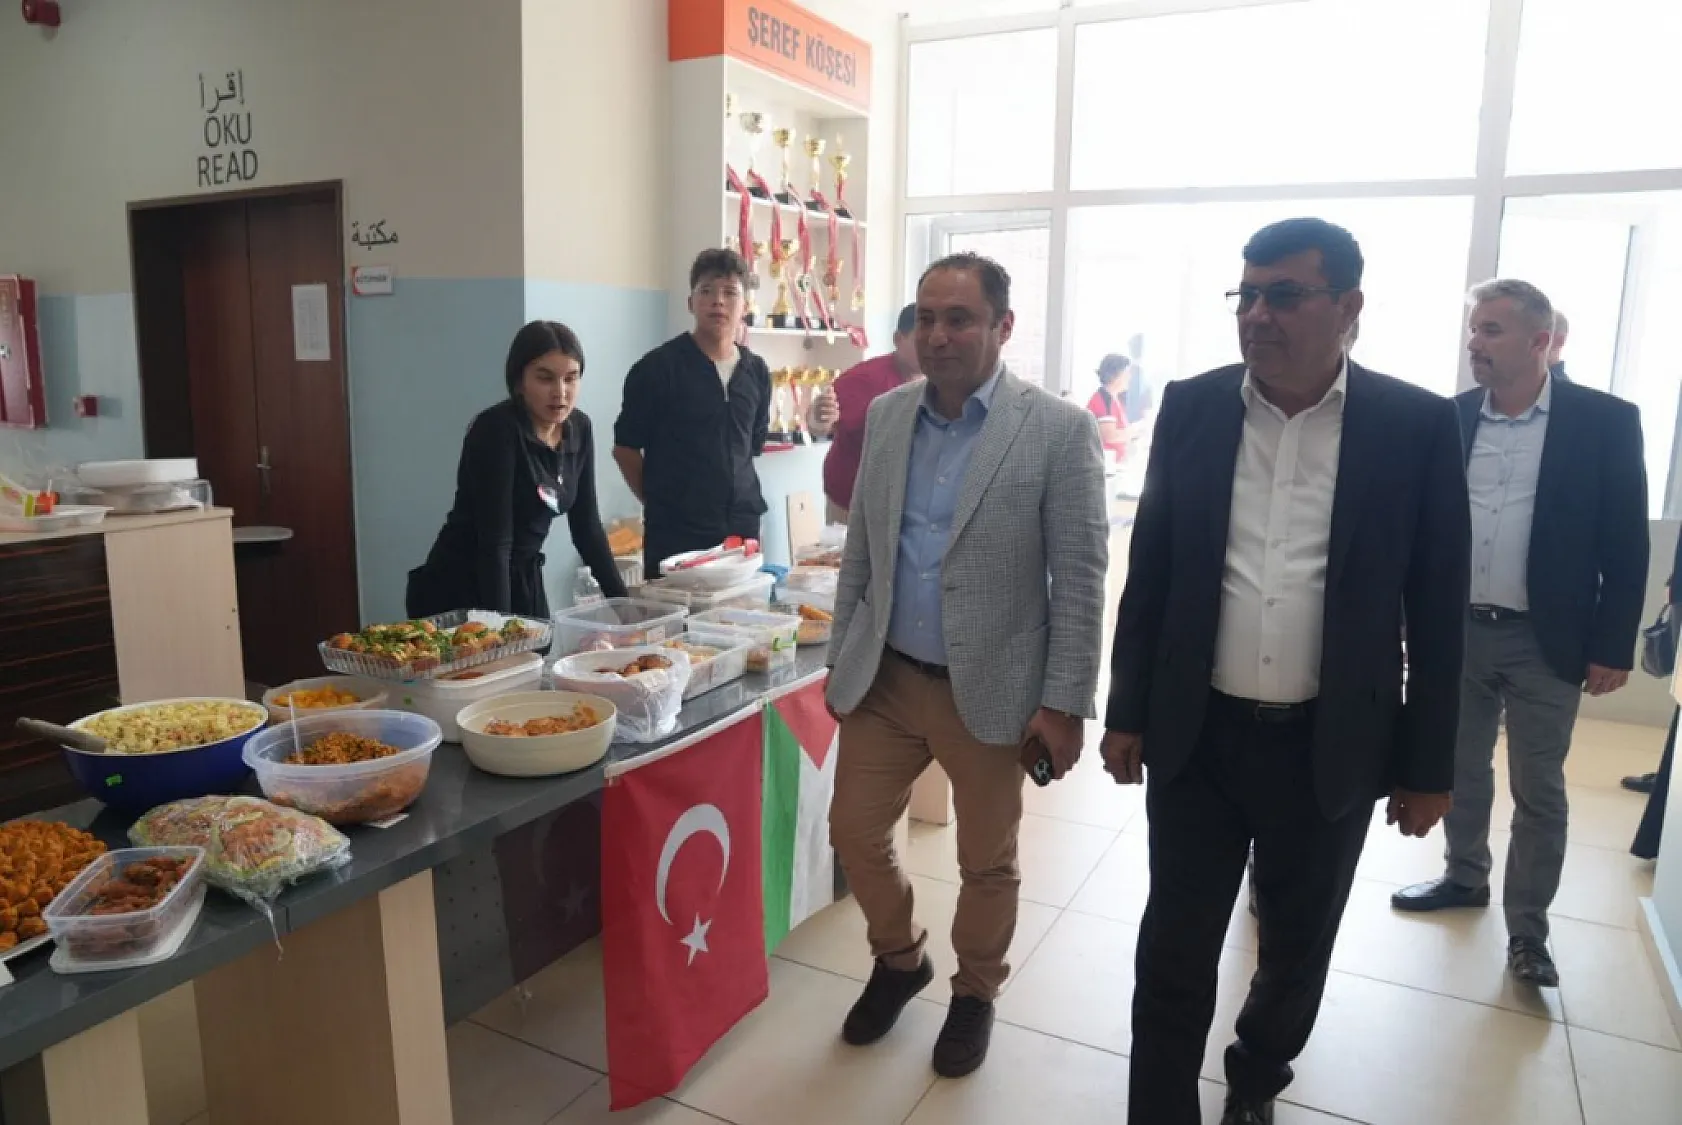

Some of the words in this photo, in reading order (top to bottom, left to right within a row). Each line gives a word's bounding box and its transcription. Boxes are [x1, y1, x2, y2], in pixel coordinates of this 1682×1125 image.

[748, 7, 800, 61] ŞEREF
[805, 33, 856, 87] KÖŞESİ
[204, 112, 252, 148] OKU
[198, 149, 258, 187] READ
[352, 219, 399, 251] مكتبة
